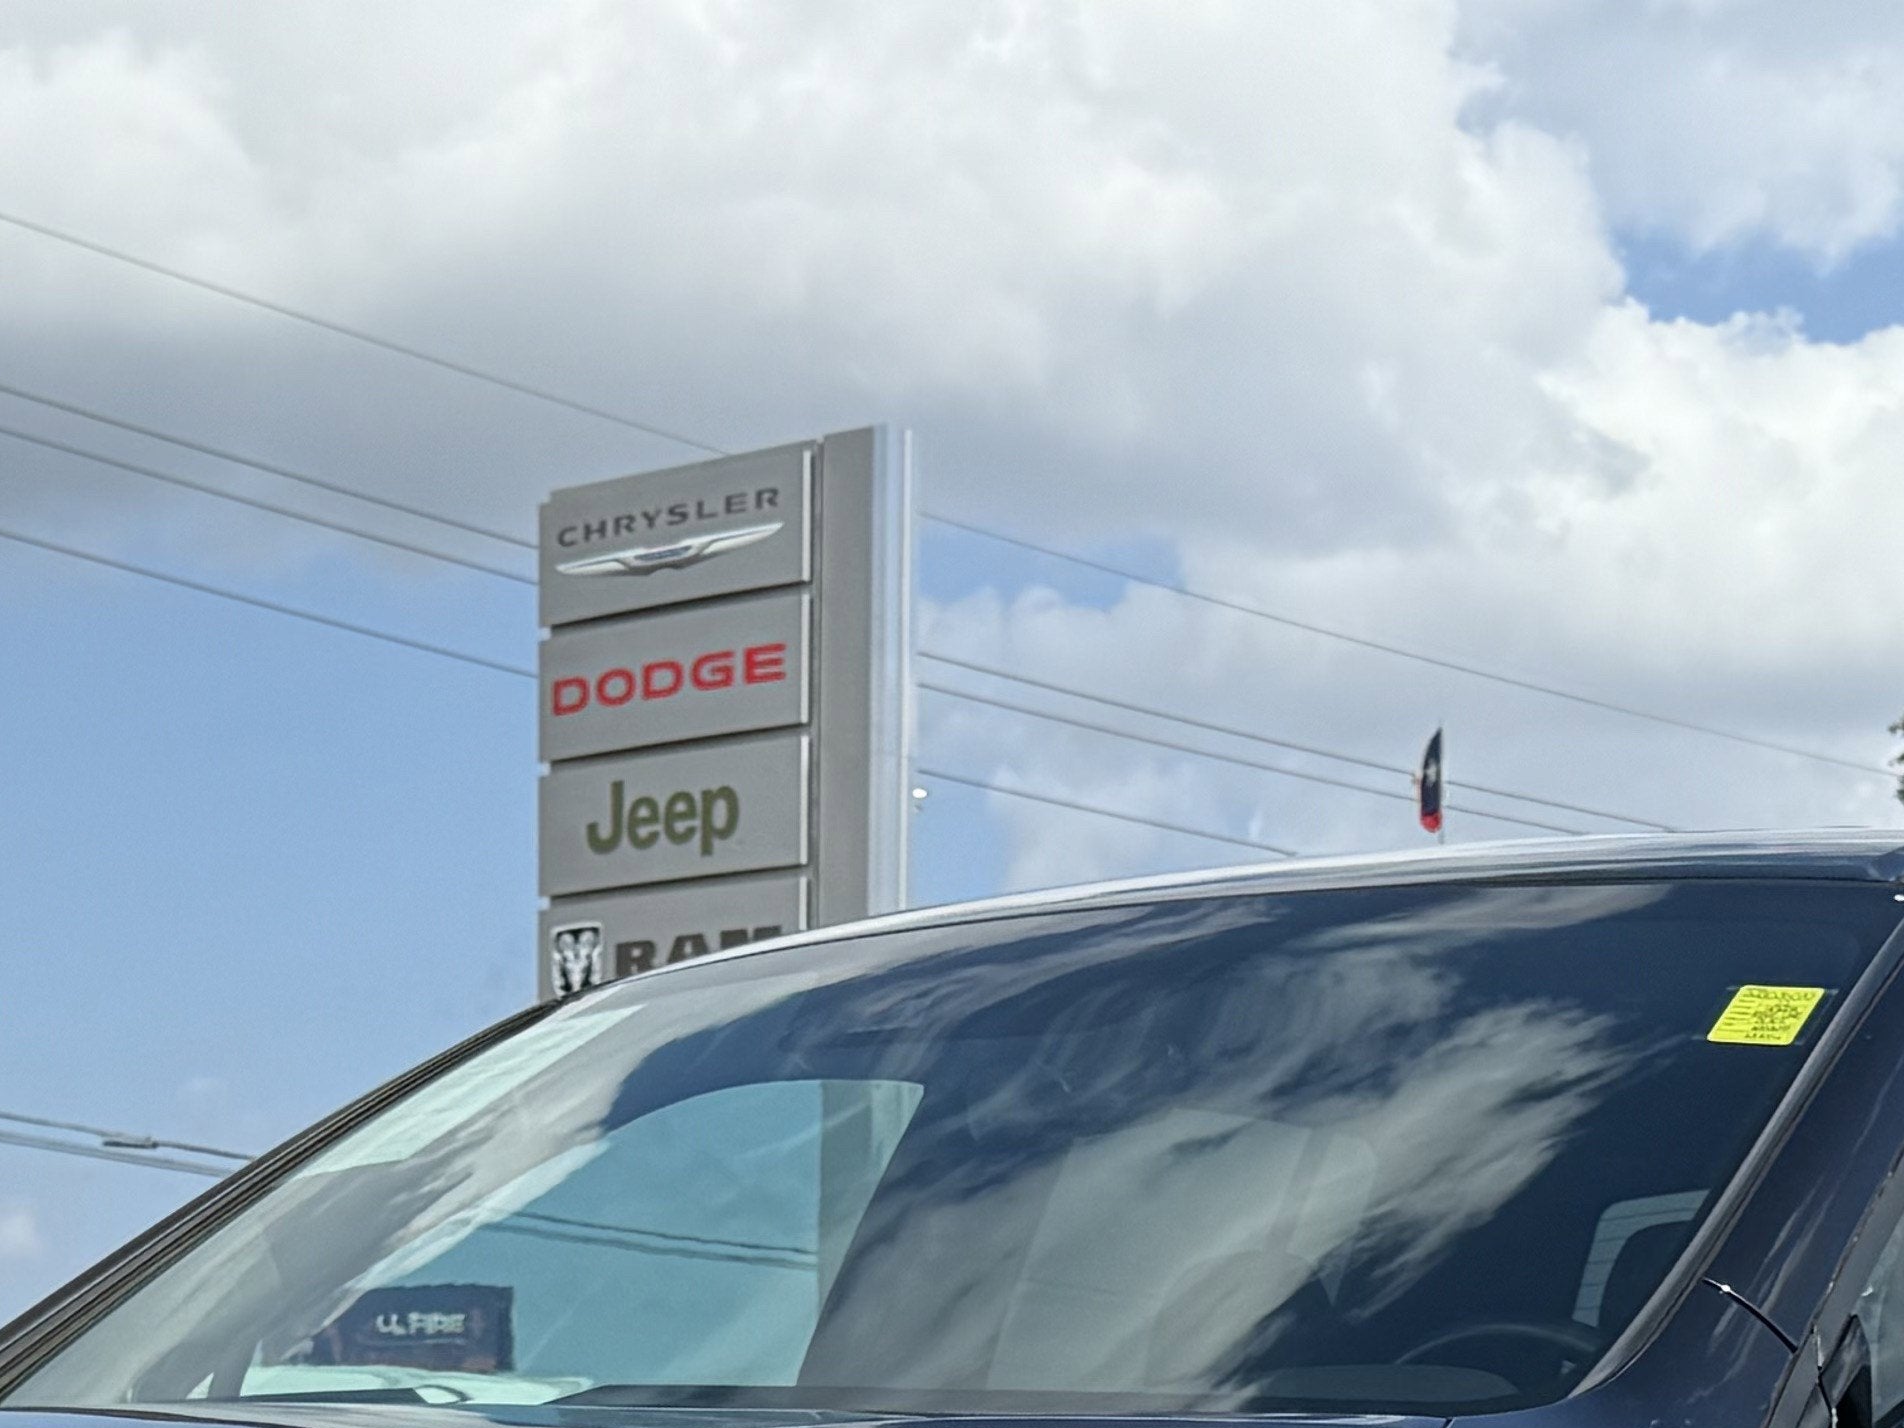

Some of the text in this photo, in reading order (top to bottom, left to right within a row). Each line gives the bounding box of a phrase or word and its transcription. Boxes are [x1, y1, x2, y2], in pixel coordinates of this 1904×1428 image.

[557, 486, 782, 548] CHRYSLER
[551, 642, 787, 717] DODGE
[585, 780, 741, 857] Jeep
